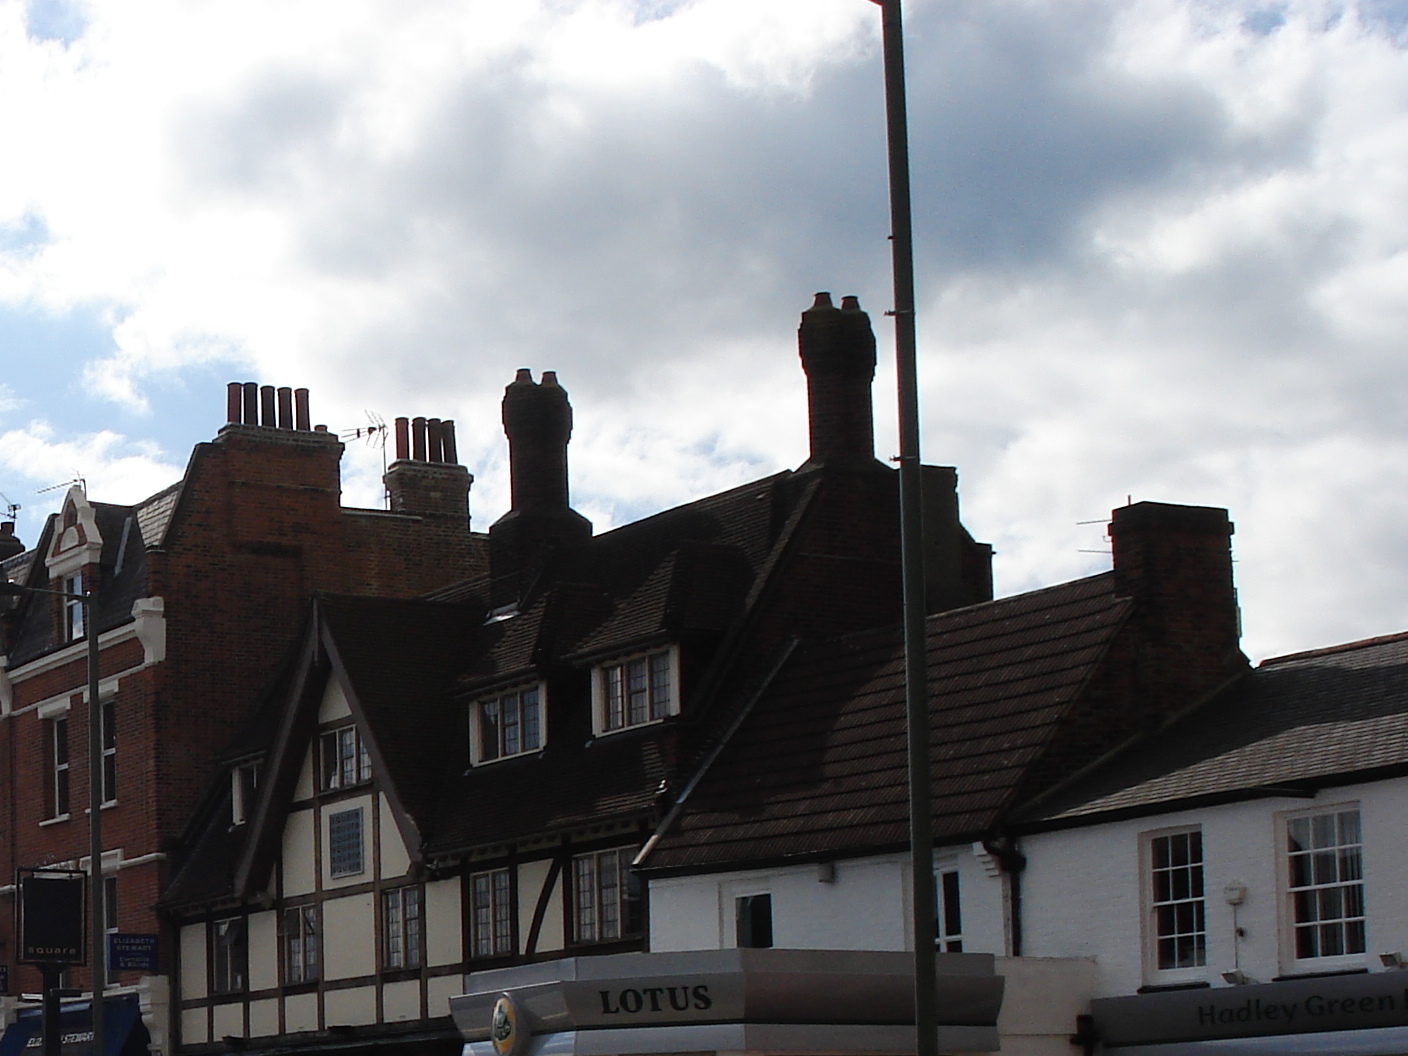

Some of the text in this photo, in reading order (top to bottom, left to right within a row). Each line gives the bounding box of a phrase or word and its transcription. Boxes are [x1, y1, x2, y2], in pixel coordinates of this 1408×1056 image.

[598, 985, 712, 1014] LOTUS
[1198, 998, 1297, 1024] Hadley
[1305, 995, 1395, 1017] Green
